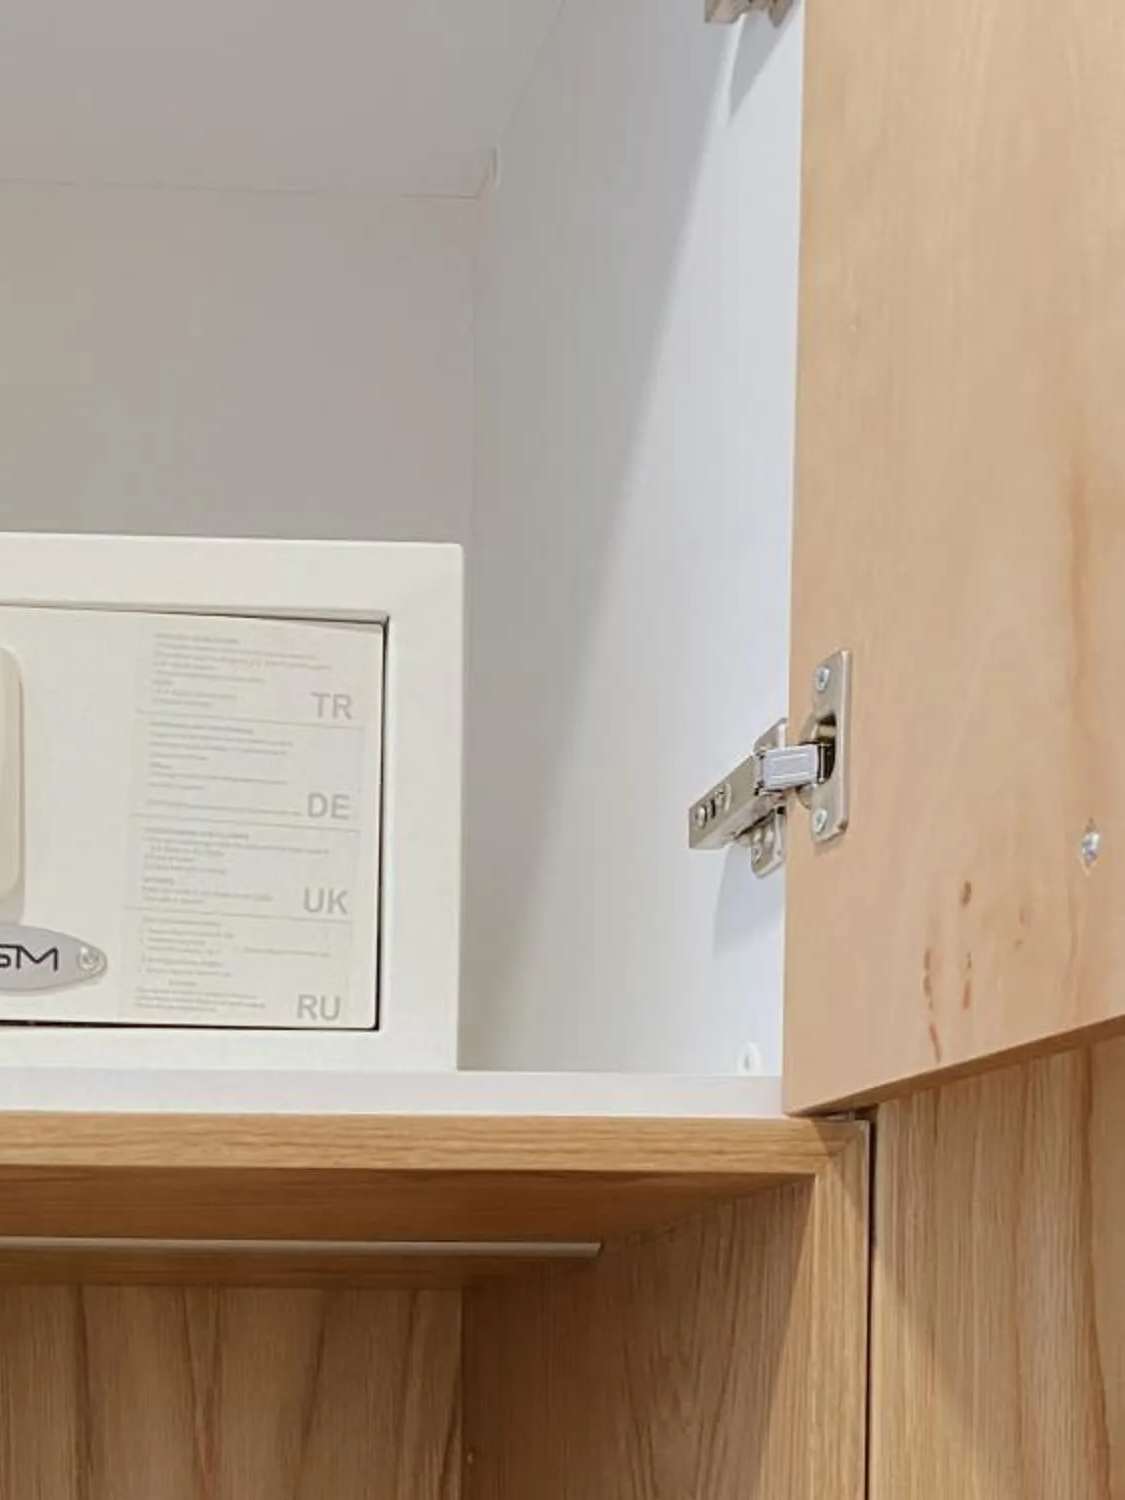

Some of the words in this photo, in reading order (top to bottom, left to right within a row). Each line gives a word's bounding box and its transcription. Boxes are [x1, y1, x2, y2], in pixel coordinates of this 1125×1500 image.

[310, 691, 353, 720] TR
[307, 791, 351, 820] DE
[303, 887, 349, 916] UK
[296, 993, 341, 1022] RU
